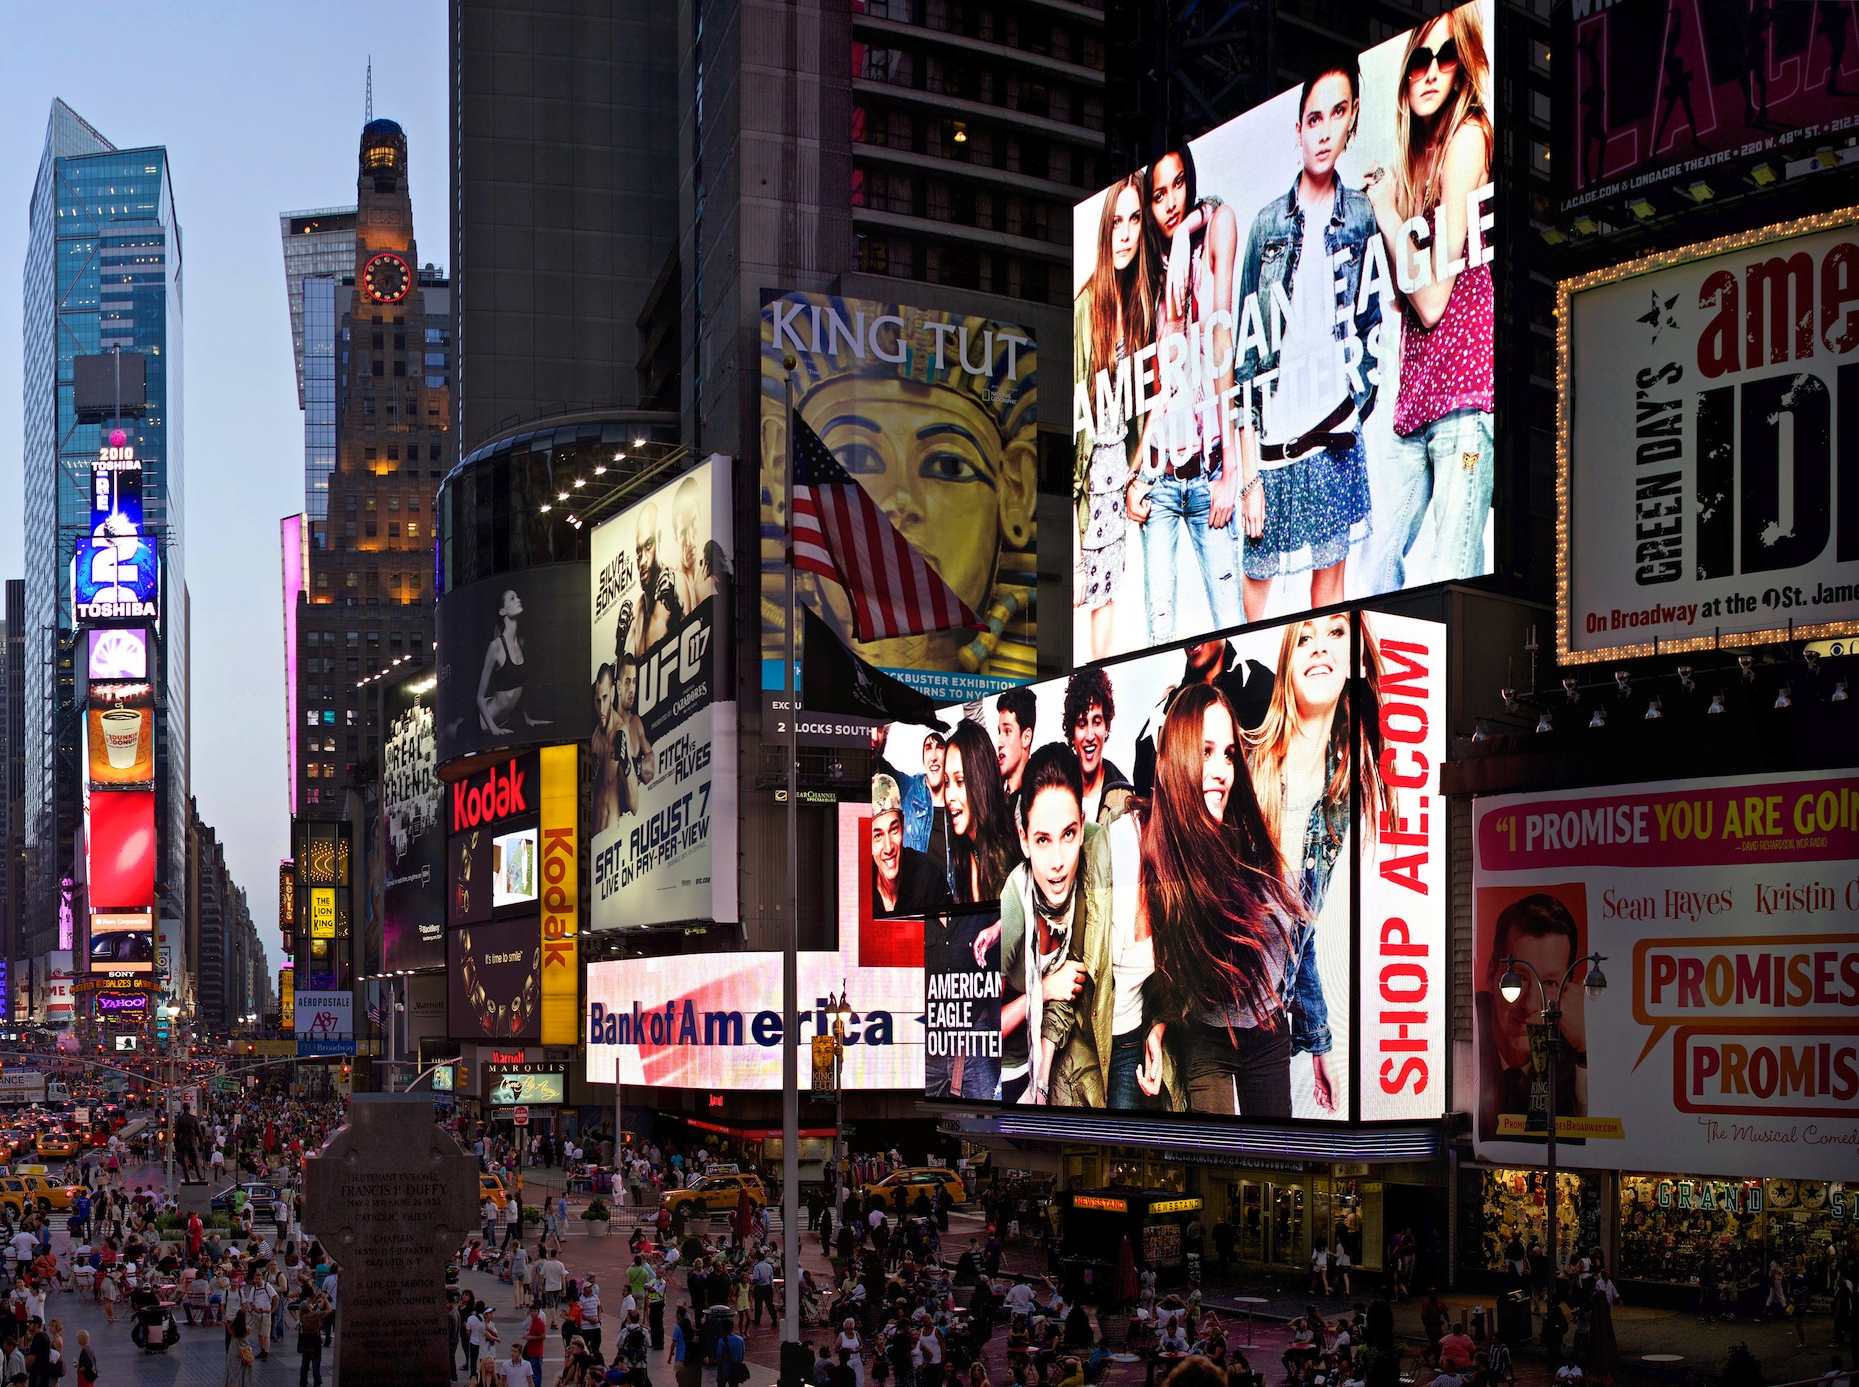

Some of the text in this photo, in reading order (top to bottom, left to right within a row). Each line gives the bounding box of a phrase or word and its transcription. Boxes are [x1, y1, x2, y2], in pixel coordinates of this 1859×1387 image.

[1560, 143, 1763, 212] LACAGE.COM LONGACRE THEATRE 220
[1332, 183, 1494, 324] EAGLE
[772, 300, 1030, 381] KING TUT
[1073, 281, 1310, 445] AMERICAN
[1142, 322, 1397, 478] OUTFITTERS
[91, 460, 142, 471] TOSHIBA
[100, 447, 134, 460] 2010
[1635, 361, 1684, 586] GREEN DAY'S
[600, 551, 624, 590] SILVA
[596, 562, 633, 616] SONNEN
[77, 602, 156, 618] TOSHIBA
[1586, 591, 1757, 634] On Broadway at the
[952, 677, 1016, 691] EXHIBITION
[659, 733, 689, 774] FITCH
[675, 741, 711, 785] ALVES
[454, 758, 527, 832] Kodak
[596, 780, 711, 885] SAT. AUGUST 7
[1525, 796, 1784, 852] PROMISE YOU ARE
[601, 815, 710, 900] LIVE PAY-PER-VIEW
[1742, 840, 1759, 852] DAVID
[1379, 638, 1429, 1095] AE.COM SHOP
[544, 828, 574, 968] Kodak
[1603, 882, 1837, 922] Sean Hayes Kristin
[118, 918, 148, 926] Corporation
[314, 906, 332, 917] LION
[99, 998, 146, 1008] YAHOO!
[298, 997, 350, 1007] AÉROPOSTALE
[414, 1001, 444, 1010] Marriott
[927, 1002, 972, 1028] EAGLE
[591, 998, 893, 1046] Bank of America
[317, 1043, 355, 1053] Broadway
[492, 1049, 525, 1063] Marriott
[489, 1064, 565, 1072] MARQUIS
[500, 1075, 560, 1100] Come Fly Away
[1698, 1117, 1798, 1144] The Musical
[1170, 1151, 1301, 1171] AMERICAN EAGLE OUTFITTERS
[341, 1184, 447, 1196] FRANCIS DUFFY
[348, 1173, 438, 1182] LIEUTENANT COLONEL
[1074, 1196, 1127, 1213] NEWSSTAND
[1150, 1198, 1200, 1215] NEWSSTAND
[1658, 1181, 1764, 1213] GRAND
[355, 1213, 434, 1221] CATHOLIC PRIEST
